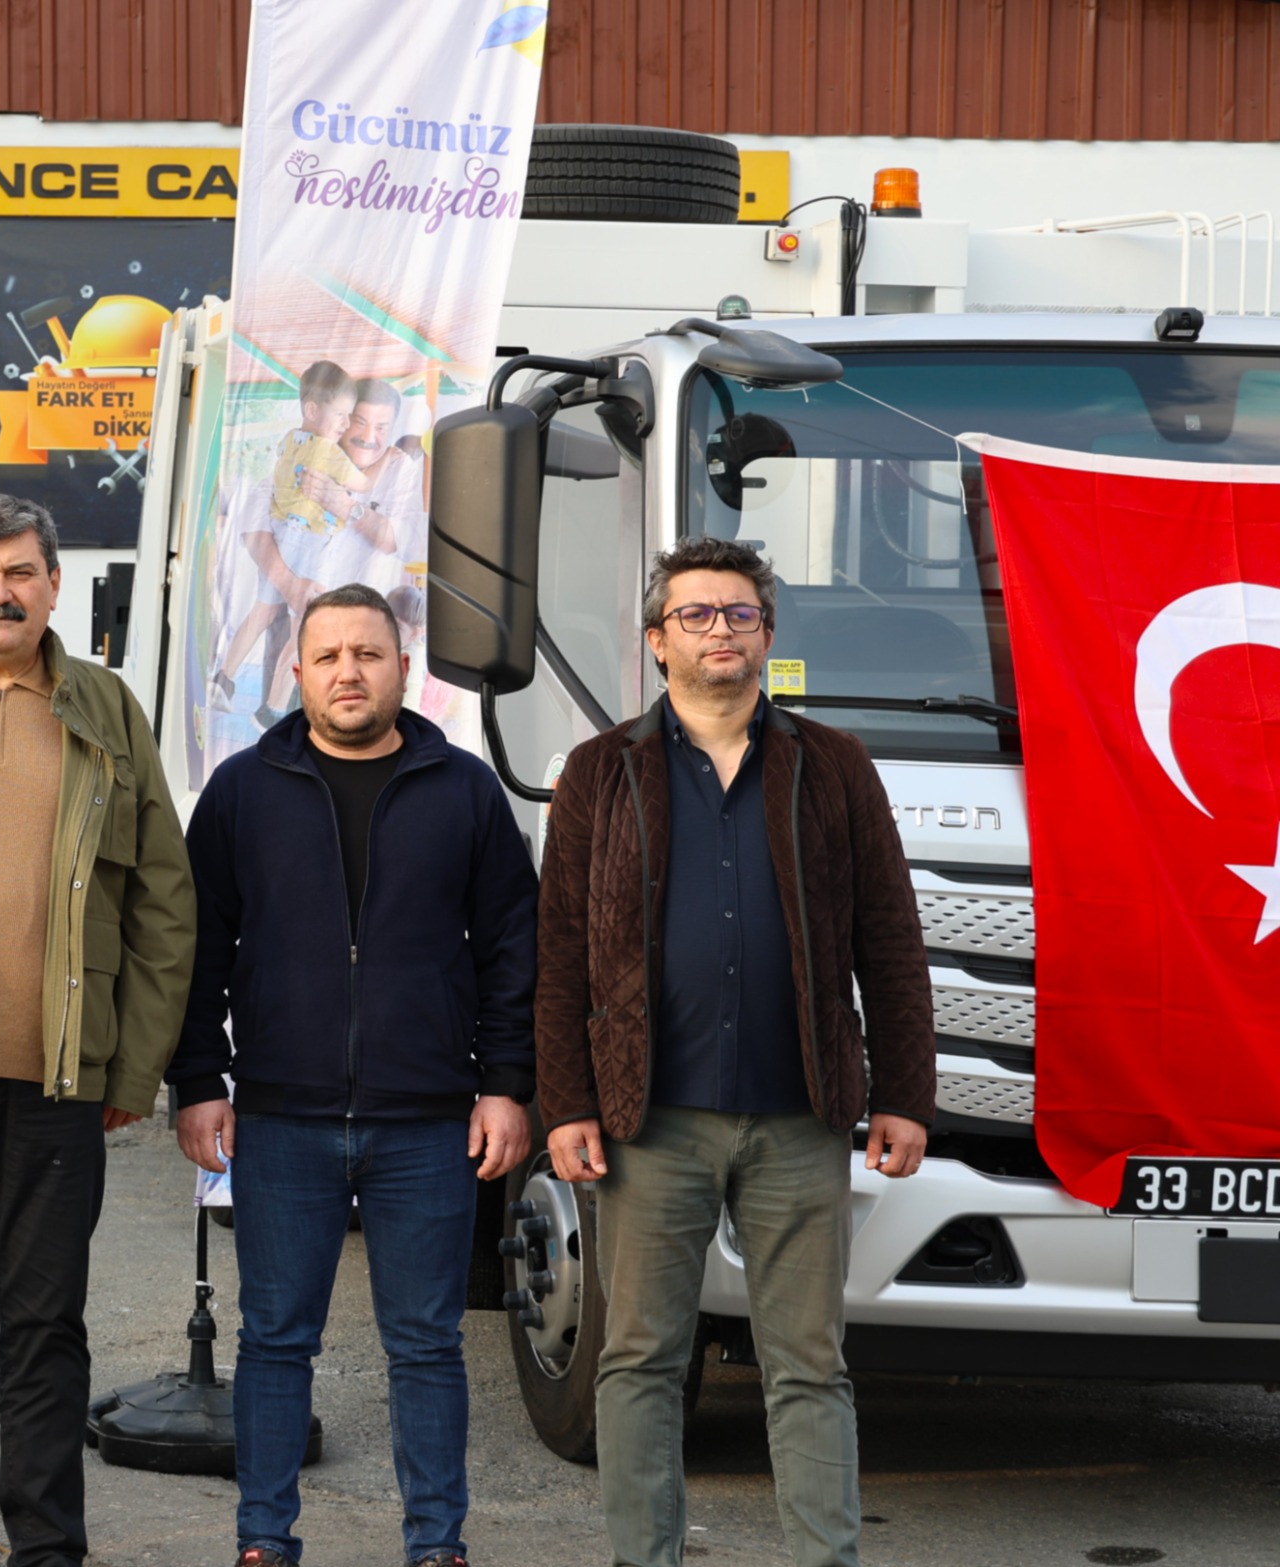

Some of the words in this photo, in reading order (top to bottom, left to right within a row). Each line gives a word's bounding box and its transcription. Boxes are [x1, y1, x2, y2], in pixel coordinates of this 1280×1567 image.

[292, 99, 512, 156] Gücümüz
[146, 163, 238, 201] CA
[285, 151, 518, 234] neslimizden
[36, 381, 75, 391] Hayatın
[78, 381, 116, 392] Değerli
[36, 391, 95, 408] FARK
[101, 391, 135, 408] ET!
[890, 804, 1001, 830] TON
[1136, 1166, 1188, 1210] 33
